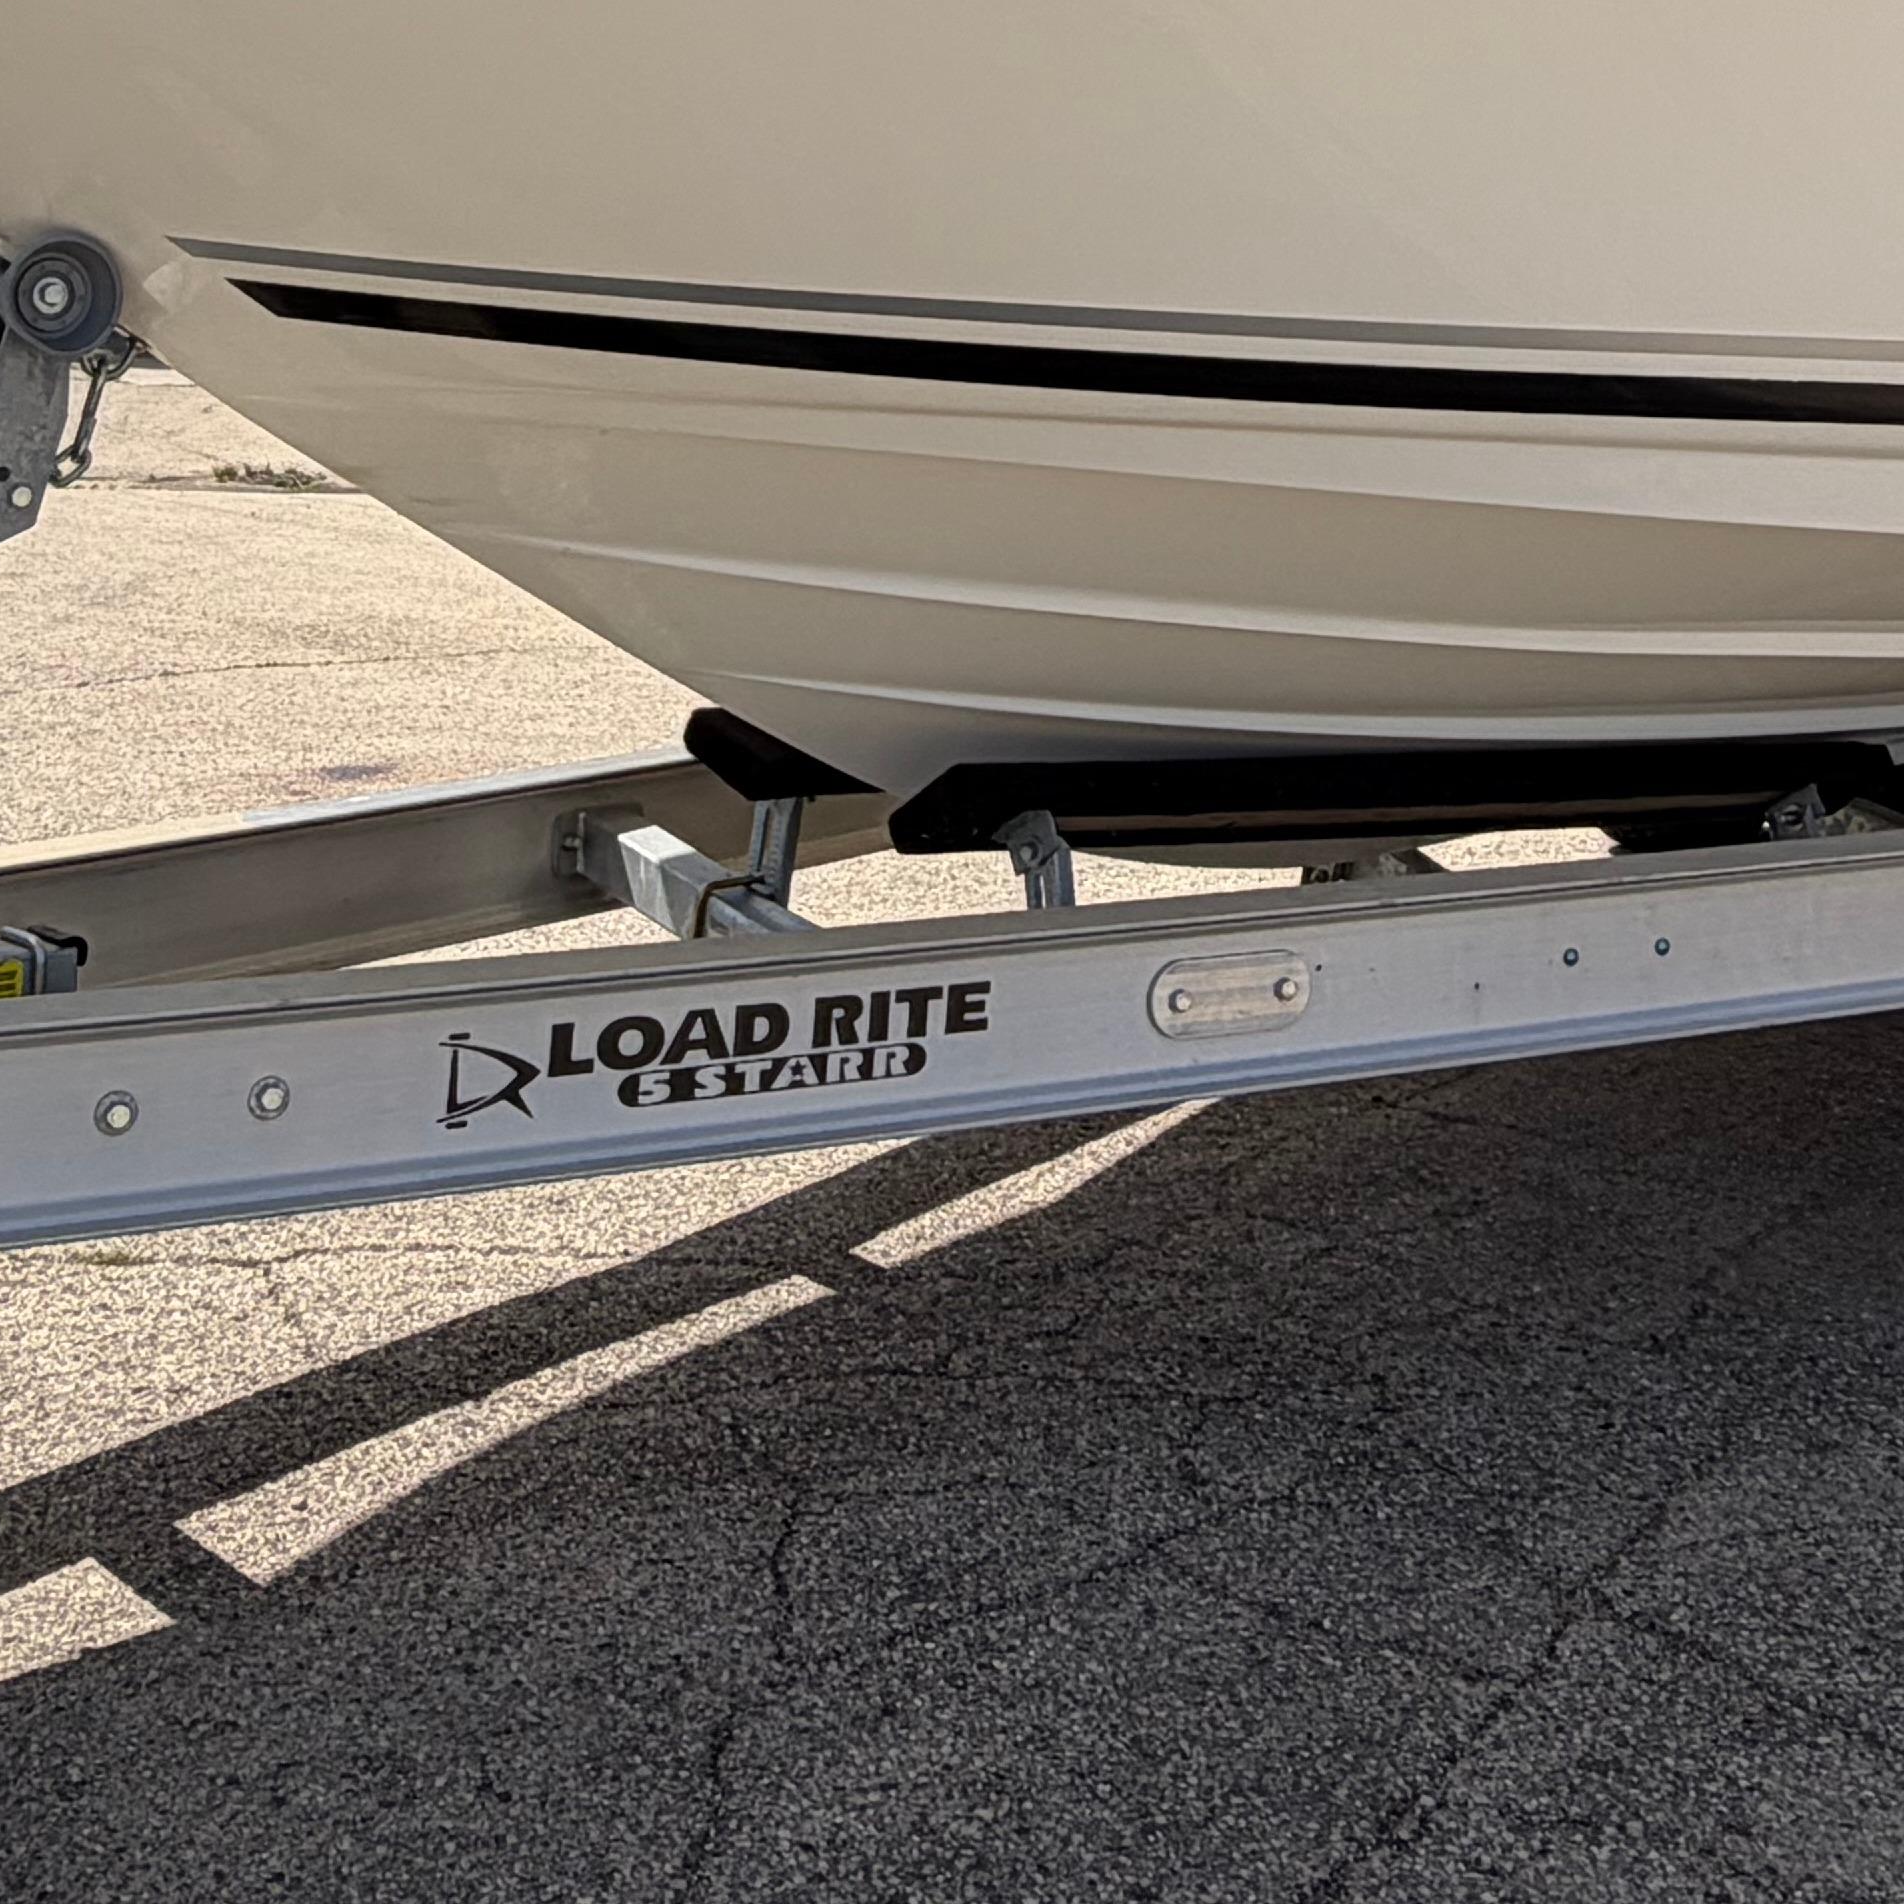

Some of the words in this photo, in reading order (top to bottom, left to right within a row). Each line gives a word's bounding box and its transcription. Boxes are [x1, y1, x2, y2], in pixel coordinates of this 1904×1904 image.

[547, 1001, 790, 1077] LOAD
[812, 980, 992, 1050] RITE
[636, 1071, 672, 1104] 5
[692, 1043, 914, 1100] STARR
